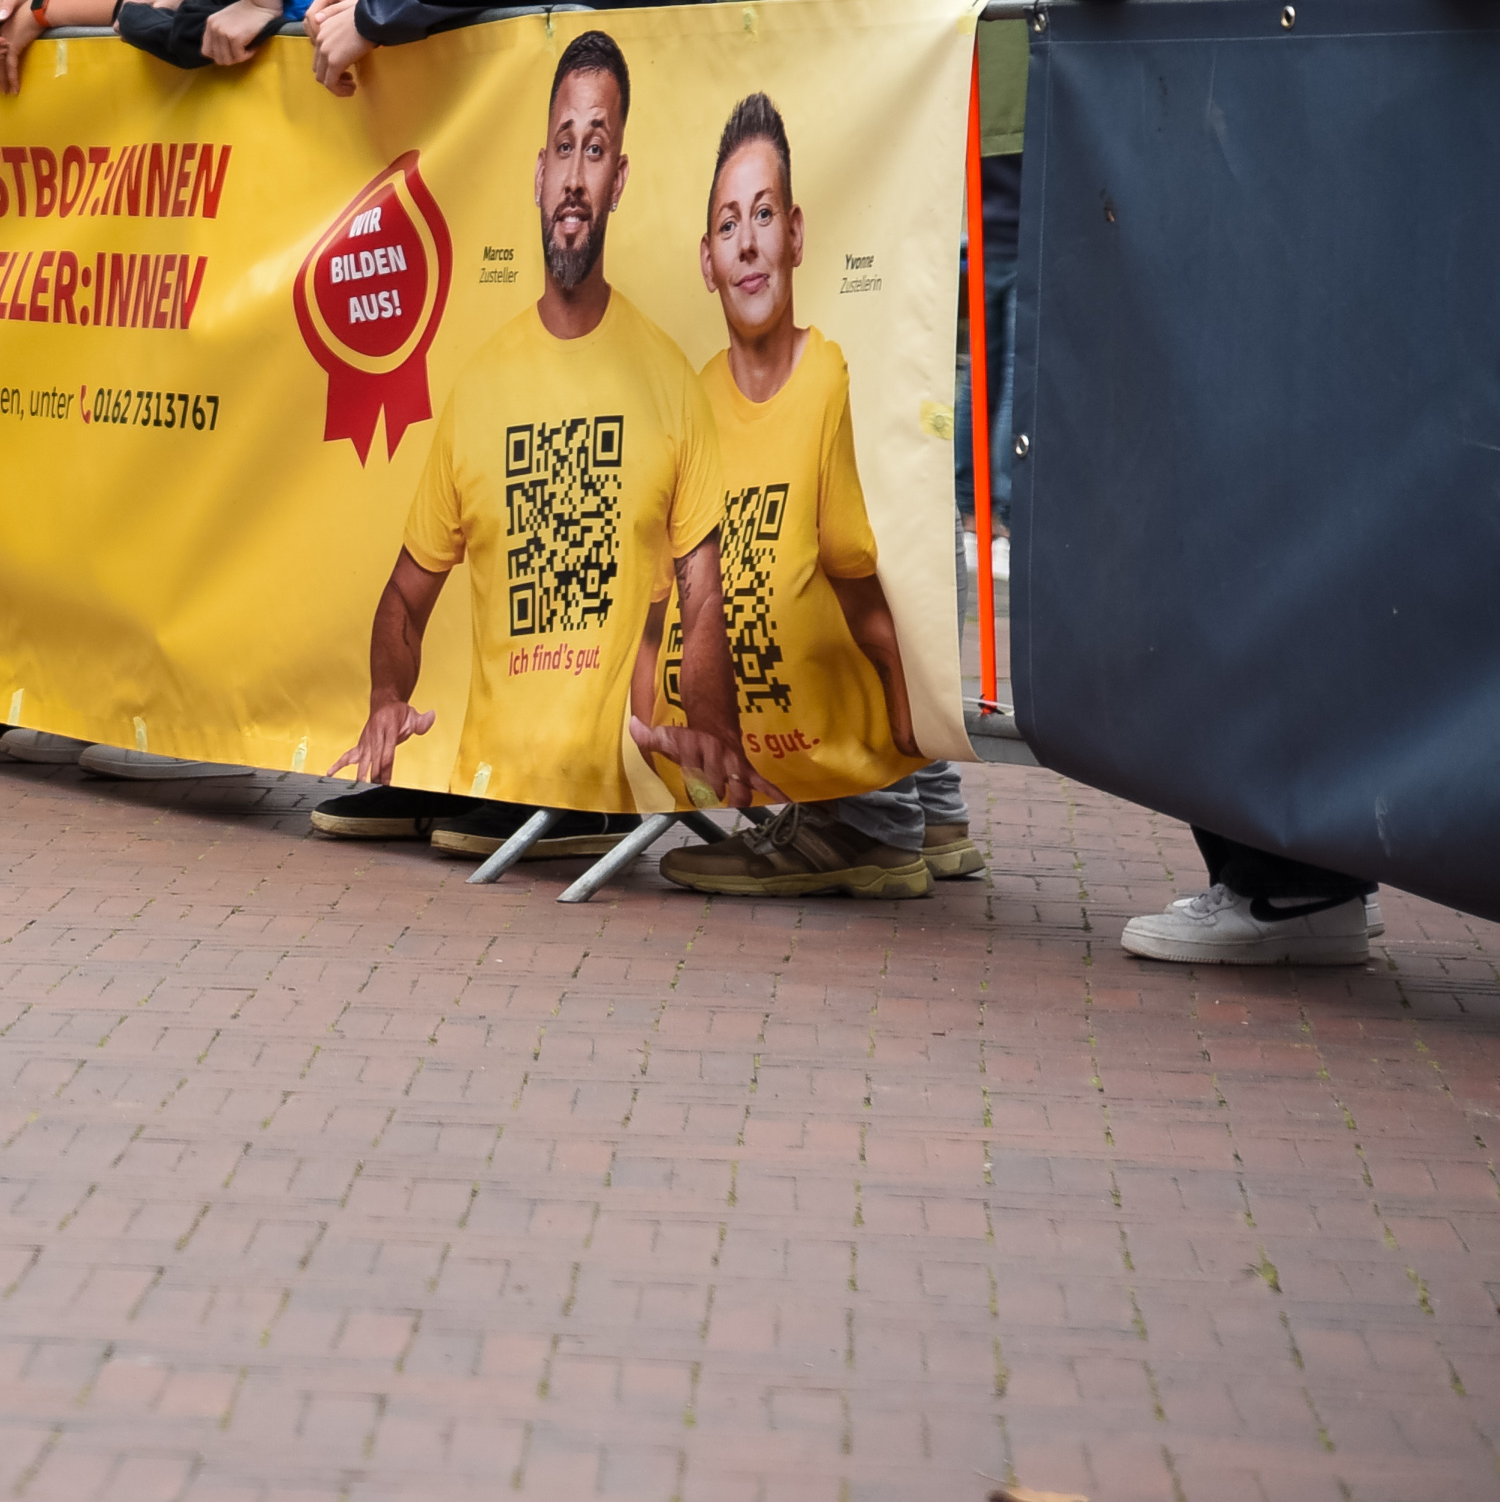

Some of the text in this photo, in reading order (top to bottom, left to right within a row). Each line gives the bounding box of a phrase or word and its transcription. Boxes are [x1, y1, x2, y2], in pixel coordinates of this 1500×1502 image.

[348, 206, 382, 238] WIR
[330, 245, 407, 284] BILDEN
[483, 246, 514, 261] Marcos
[478, 267, 519, 284] Zusteller
[349, 289, 402, 323] AUS!
[29, 386, 74, 420] unter
[93, 387, 219, 430] 01627313767
[509, 643, 600, 676] Ich find's gut.
[763, 729, 821, 759] gut.
